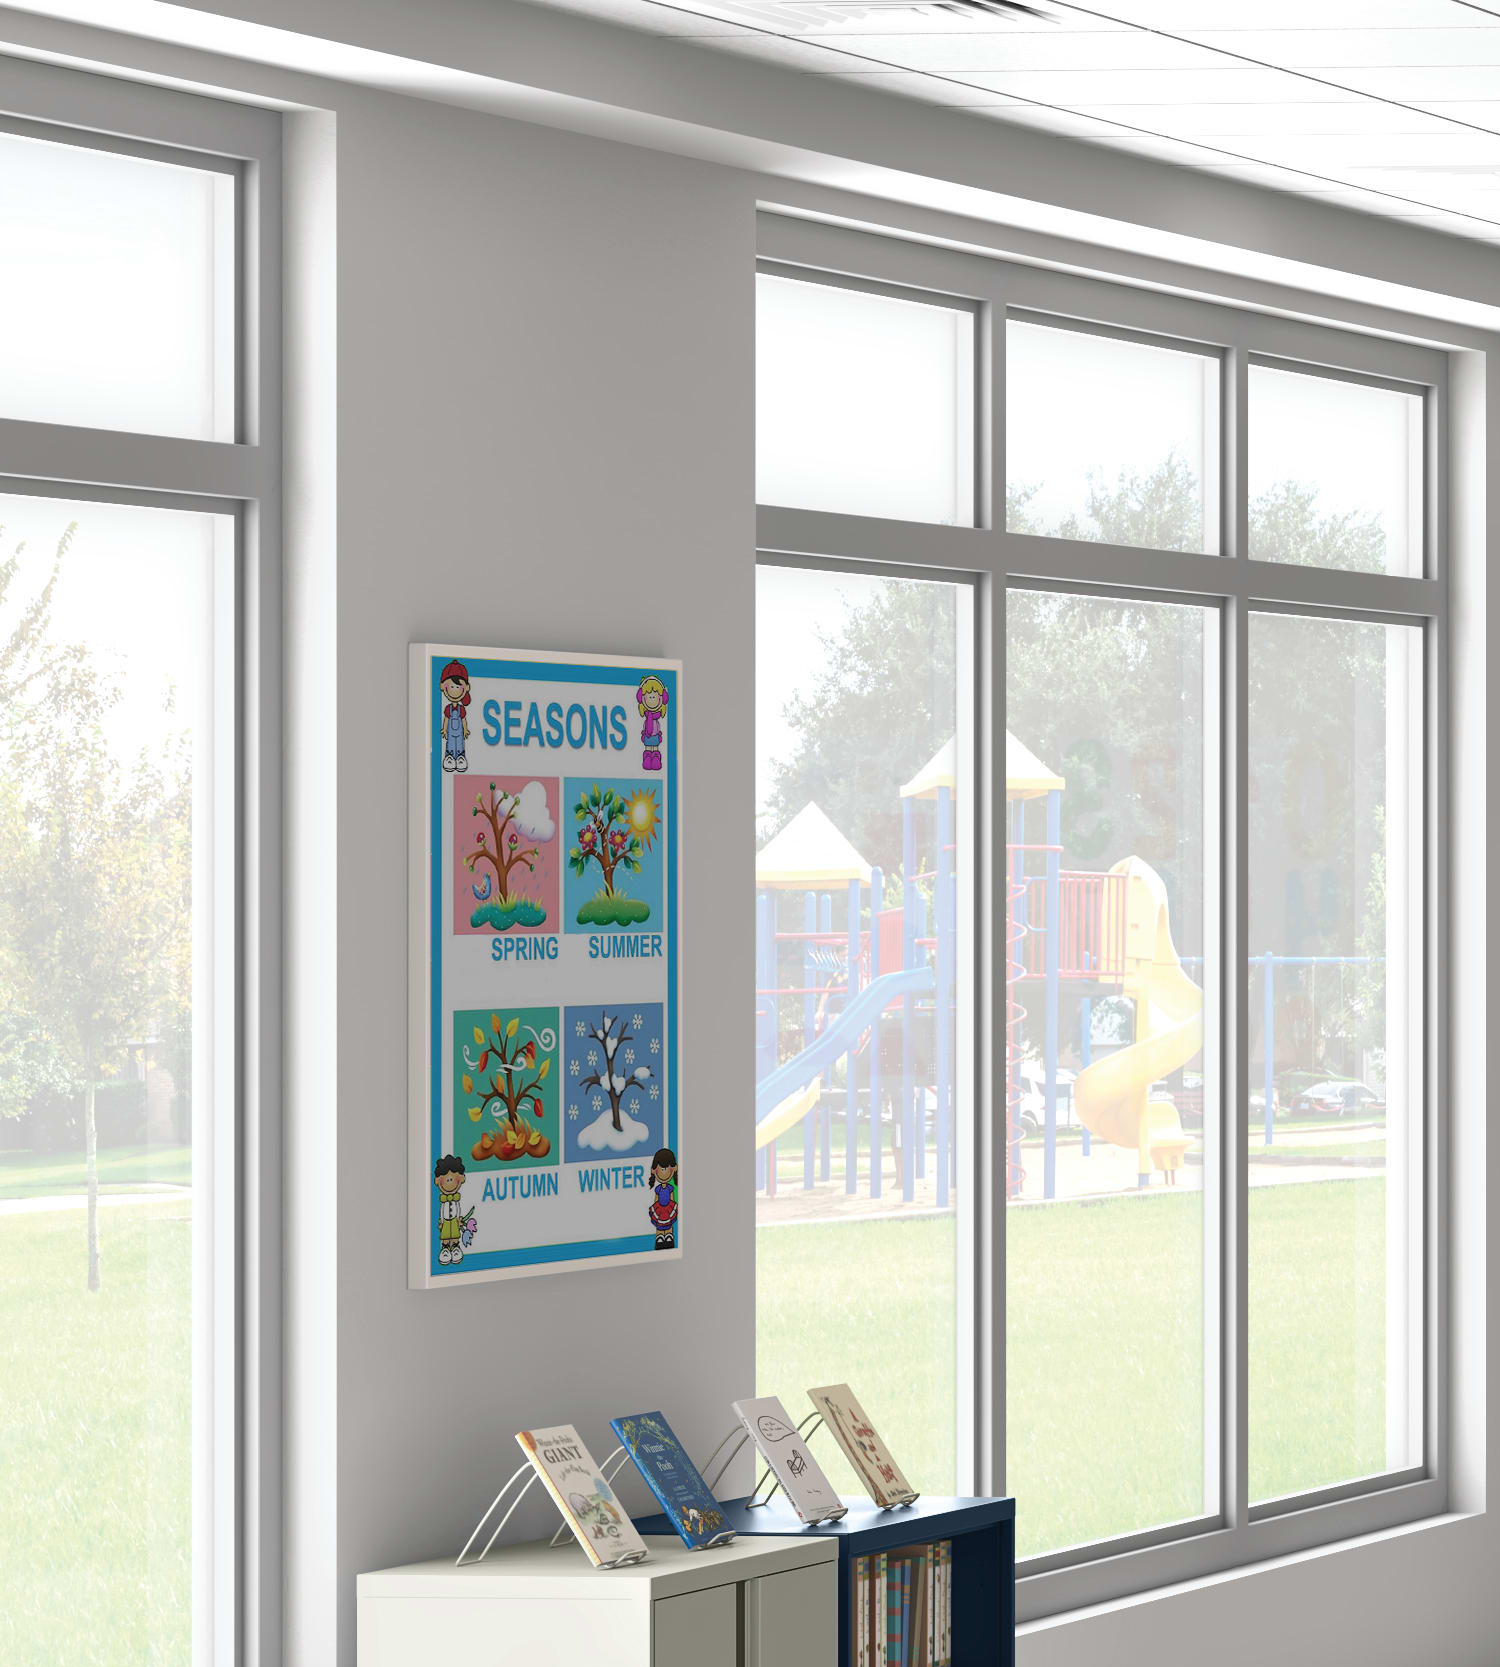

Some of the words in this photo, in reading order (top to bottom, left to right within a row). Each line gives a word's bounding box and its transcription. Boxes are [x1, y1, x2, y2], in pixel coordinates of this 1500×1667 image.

[482, 699, 628, 751] SEASONS
[490, 936, 559, 962] SPRING
[588, 934, 663, 961] SUMMER
[482, 1172, 559, 1203] AUTUMN
[577, 1166, 645, 1193] WINTER
[543, 1445, 583, 1464] GIANT
